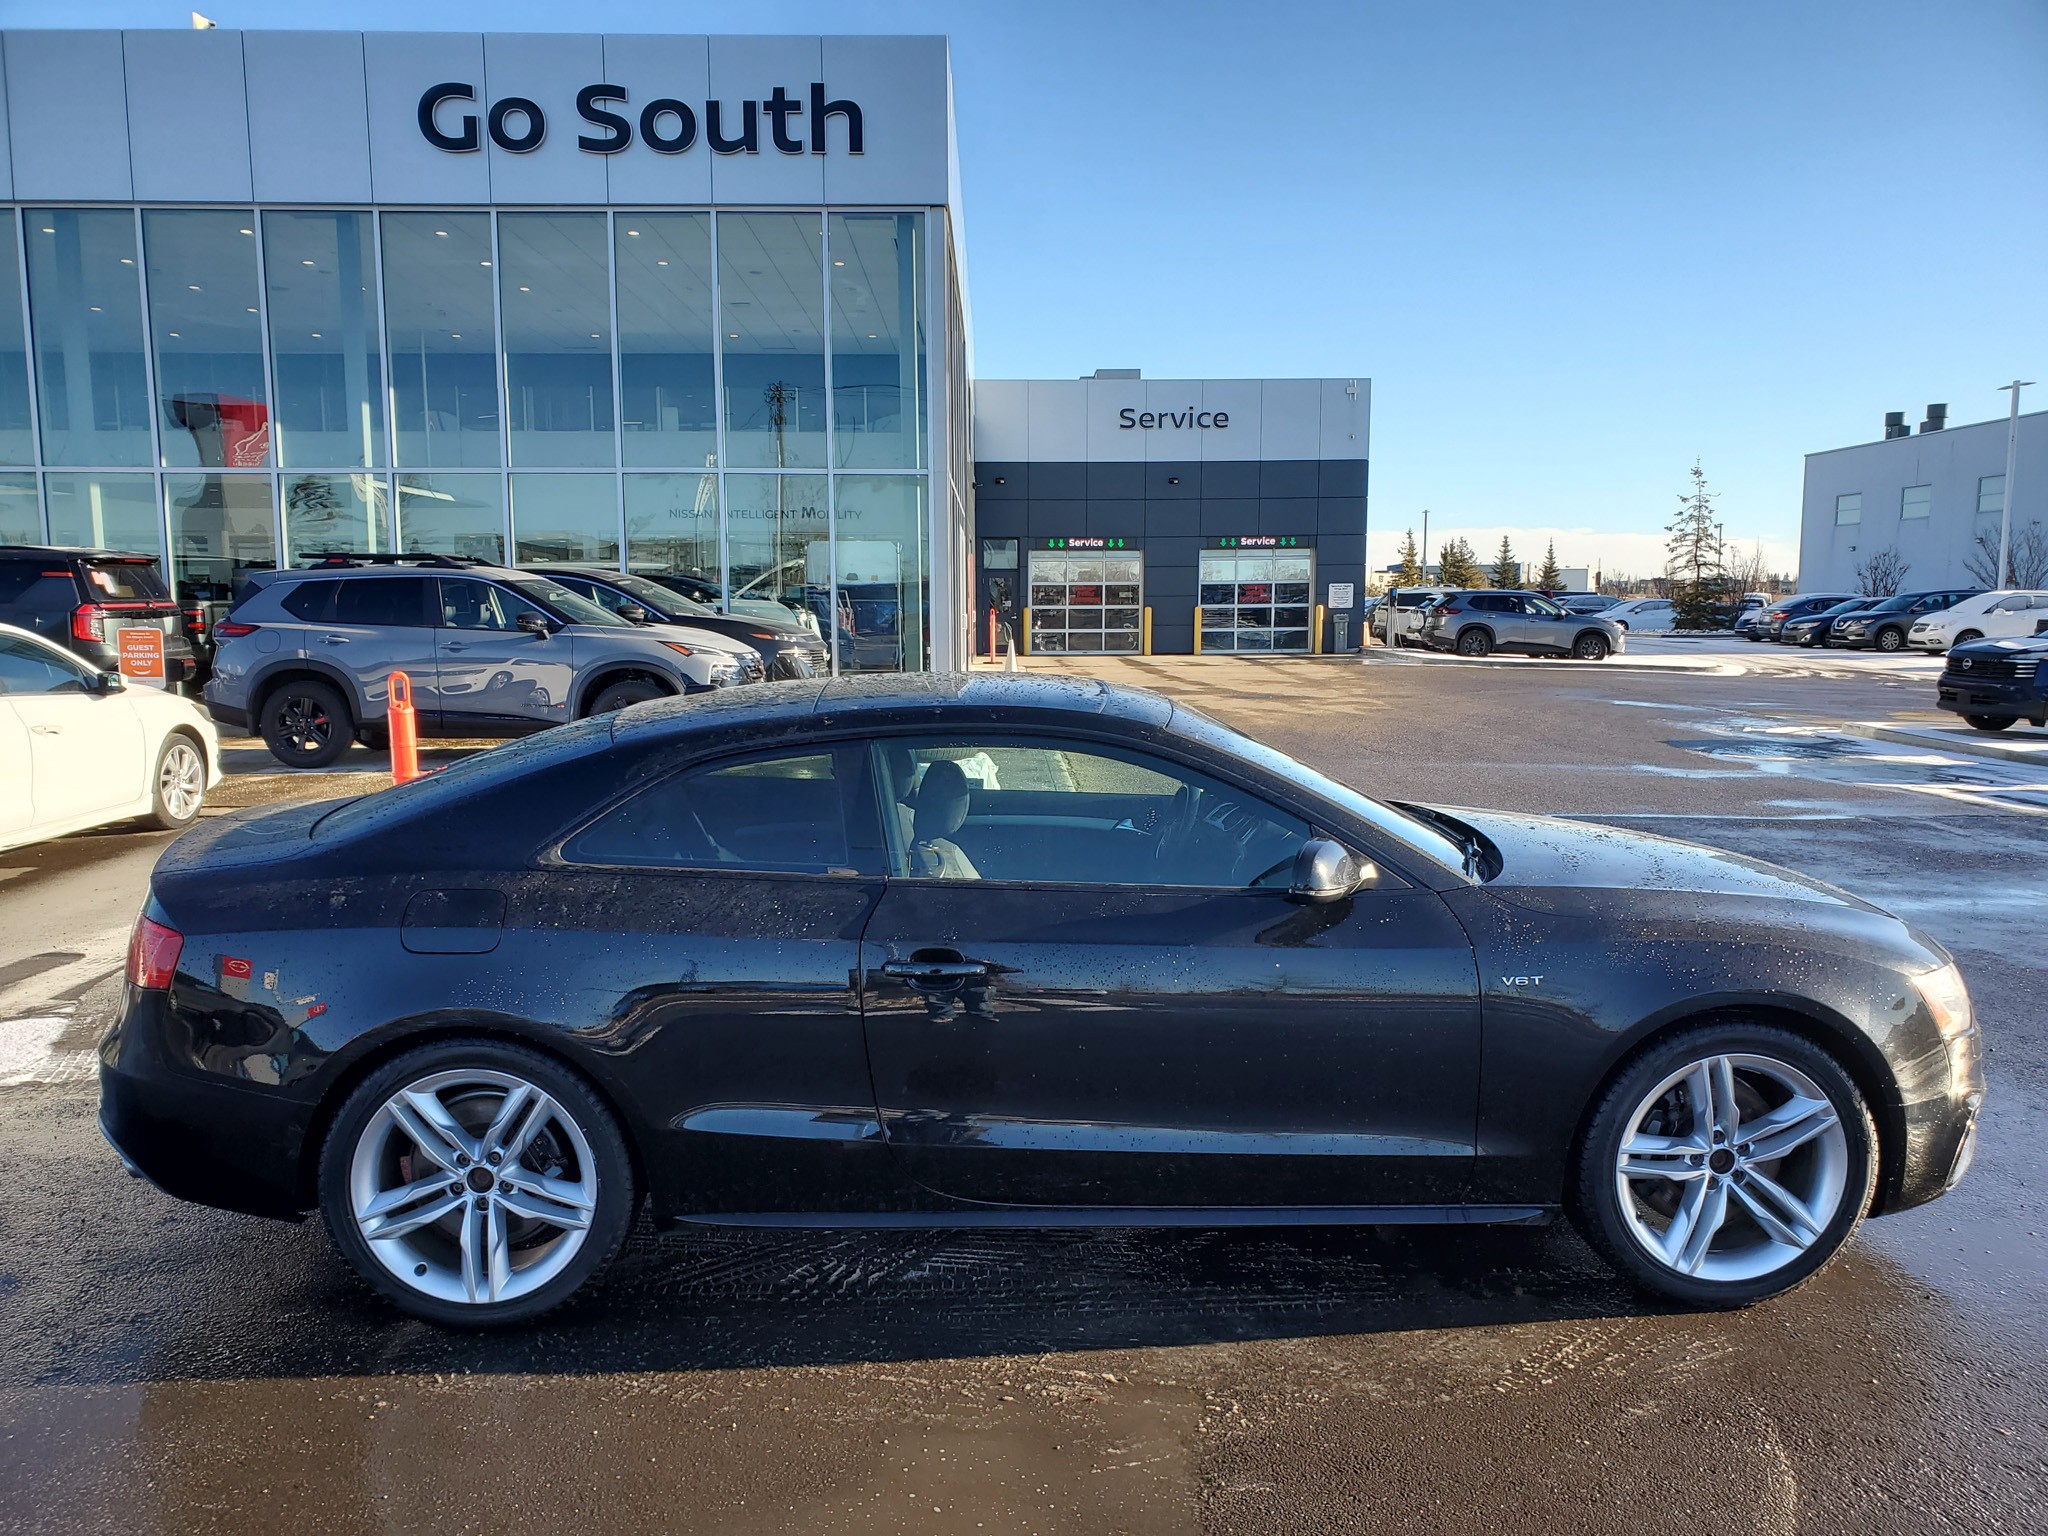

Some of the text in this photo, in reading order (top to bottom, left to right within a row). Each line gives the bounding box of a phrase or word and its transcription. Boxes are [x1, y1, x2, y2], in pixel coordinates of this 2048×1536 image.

[417, 82, 865, 155] Go South
[1119, 406, 1230, 429] Service
[669, 509, 713, 519] NISSAN
[1068, 537, 1104, 547] Service
[1240, 536, 1276, 546] Service
[1501, 975, 1544, 986] V6T
